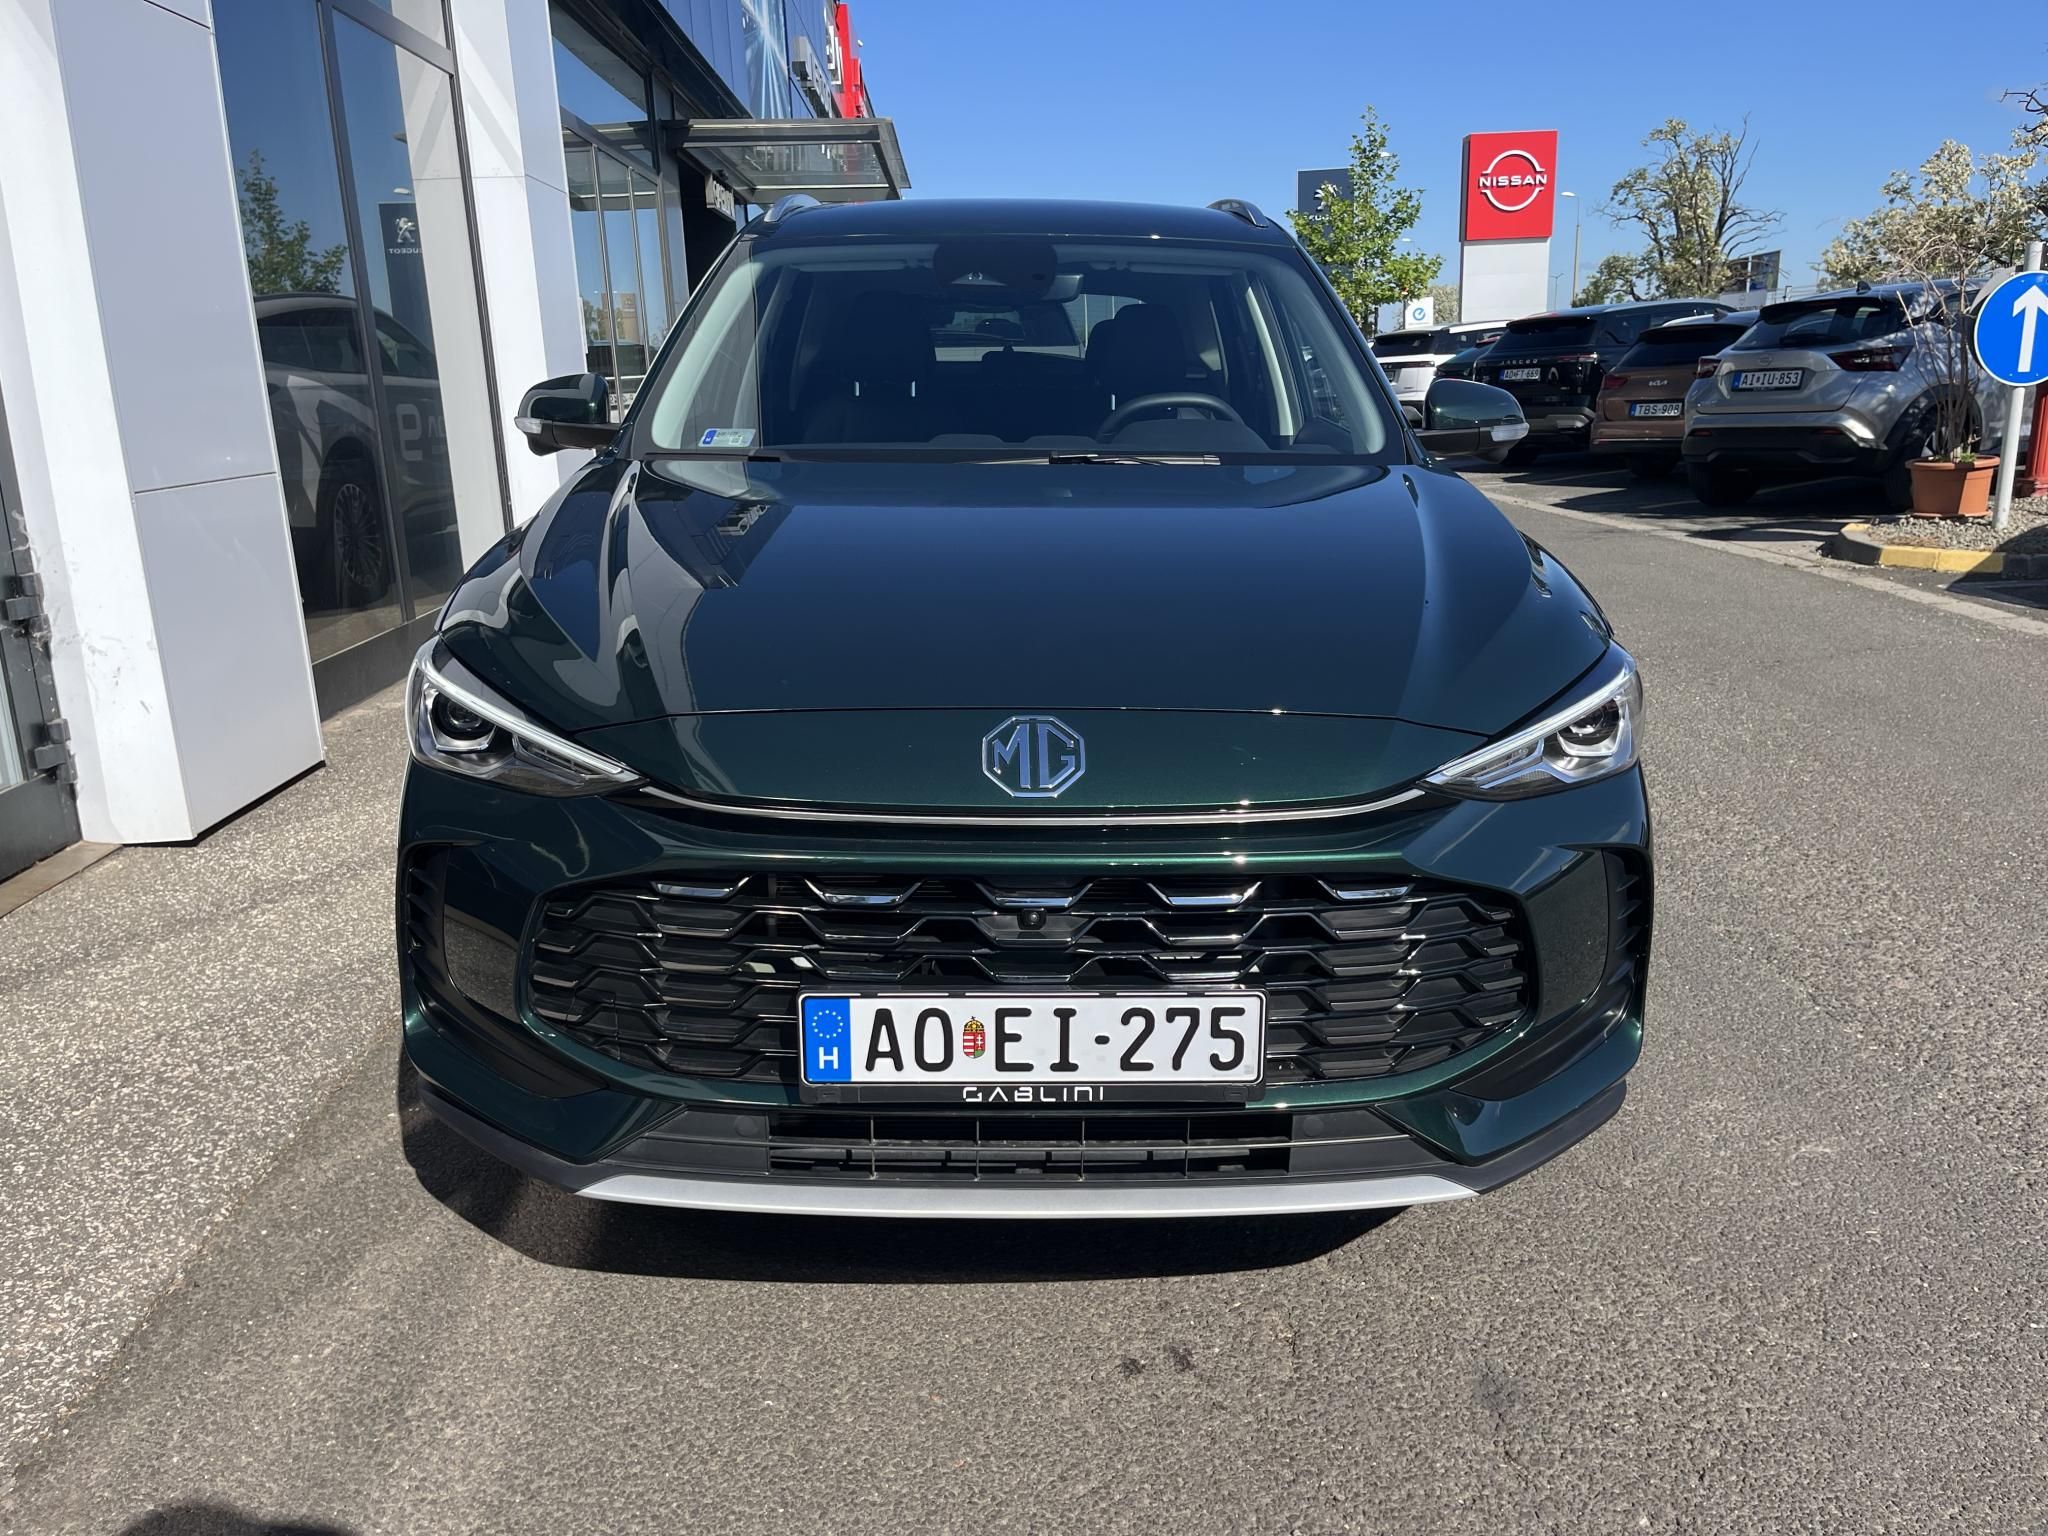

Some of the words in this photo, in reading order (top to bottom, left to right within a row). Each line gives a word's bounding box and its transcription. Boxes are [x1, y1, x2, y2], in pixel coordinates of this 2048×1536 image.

[1479, 174, 1548, 188] NISSAN
[1638, 404, 1680, 415] TBS-908
[992, 723, 1076, 789] MG
[865, 1007, 954, 1072] AO
[995, 1007, 1246, 1072] EI-275
[818, 1046, 839, 1070] H
[962, 1086, 1104, 1102] GABLINI
